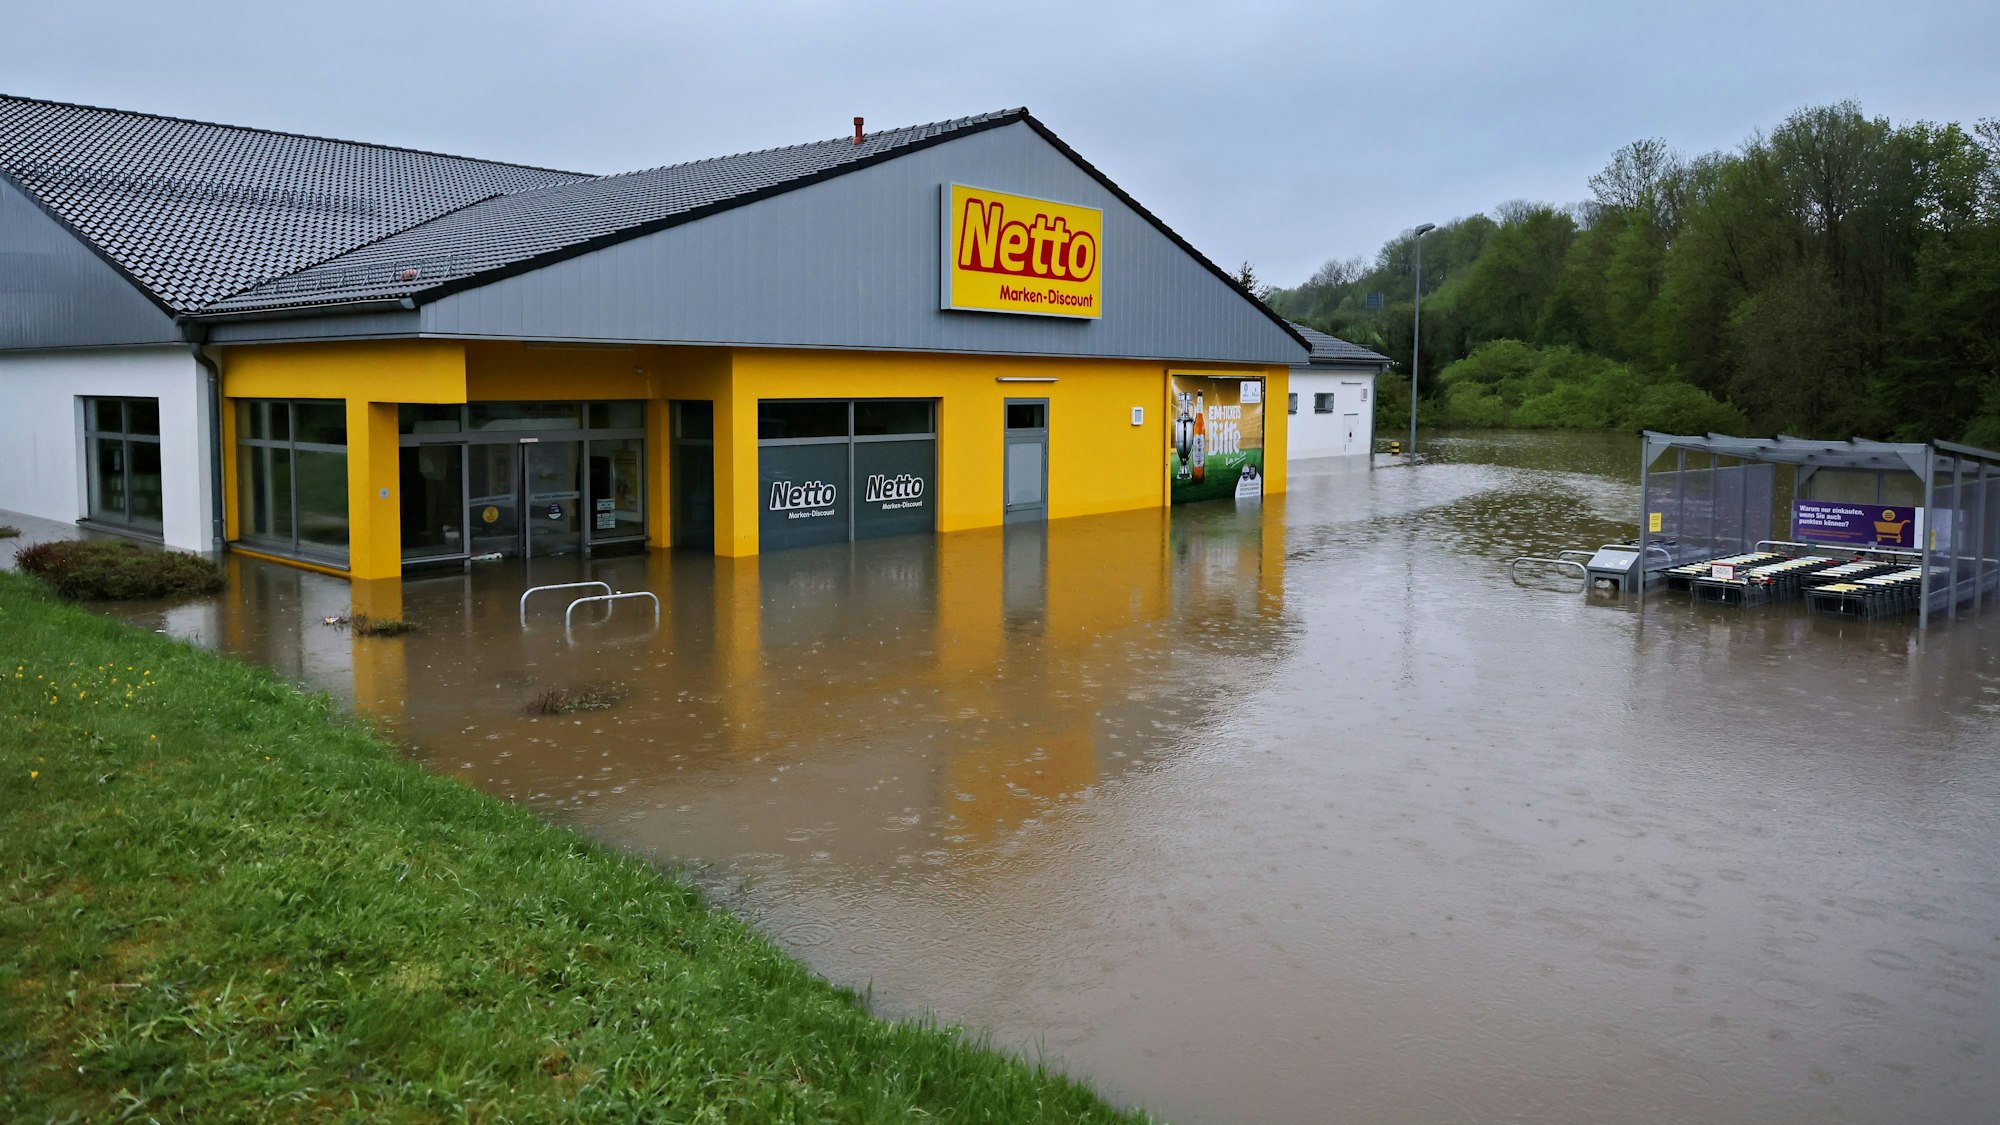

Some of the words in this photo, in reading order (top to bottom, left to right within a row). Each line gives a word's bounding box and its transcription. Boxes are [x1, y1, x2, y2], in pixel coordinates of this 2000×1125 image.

[958, 197, 1096, 282] Netto
[999, 285, 1093, 307] Marken-Discount
[770, 481, 836, 510] Netto
[866, 474, 924, 502] Netto
[788, 509, 835, 519] Marken-Discount
[882, 501, 923, 510] Marken-Discount
[1823, 519, 1849, 527] können?
